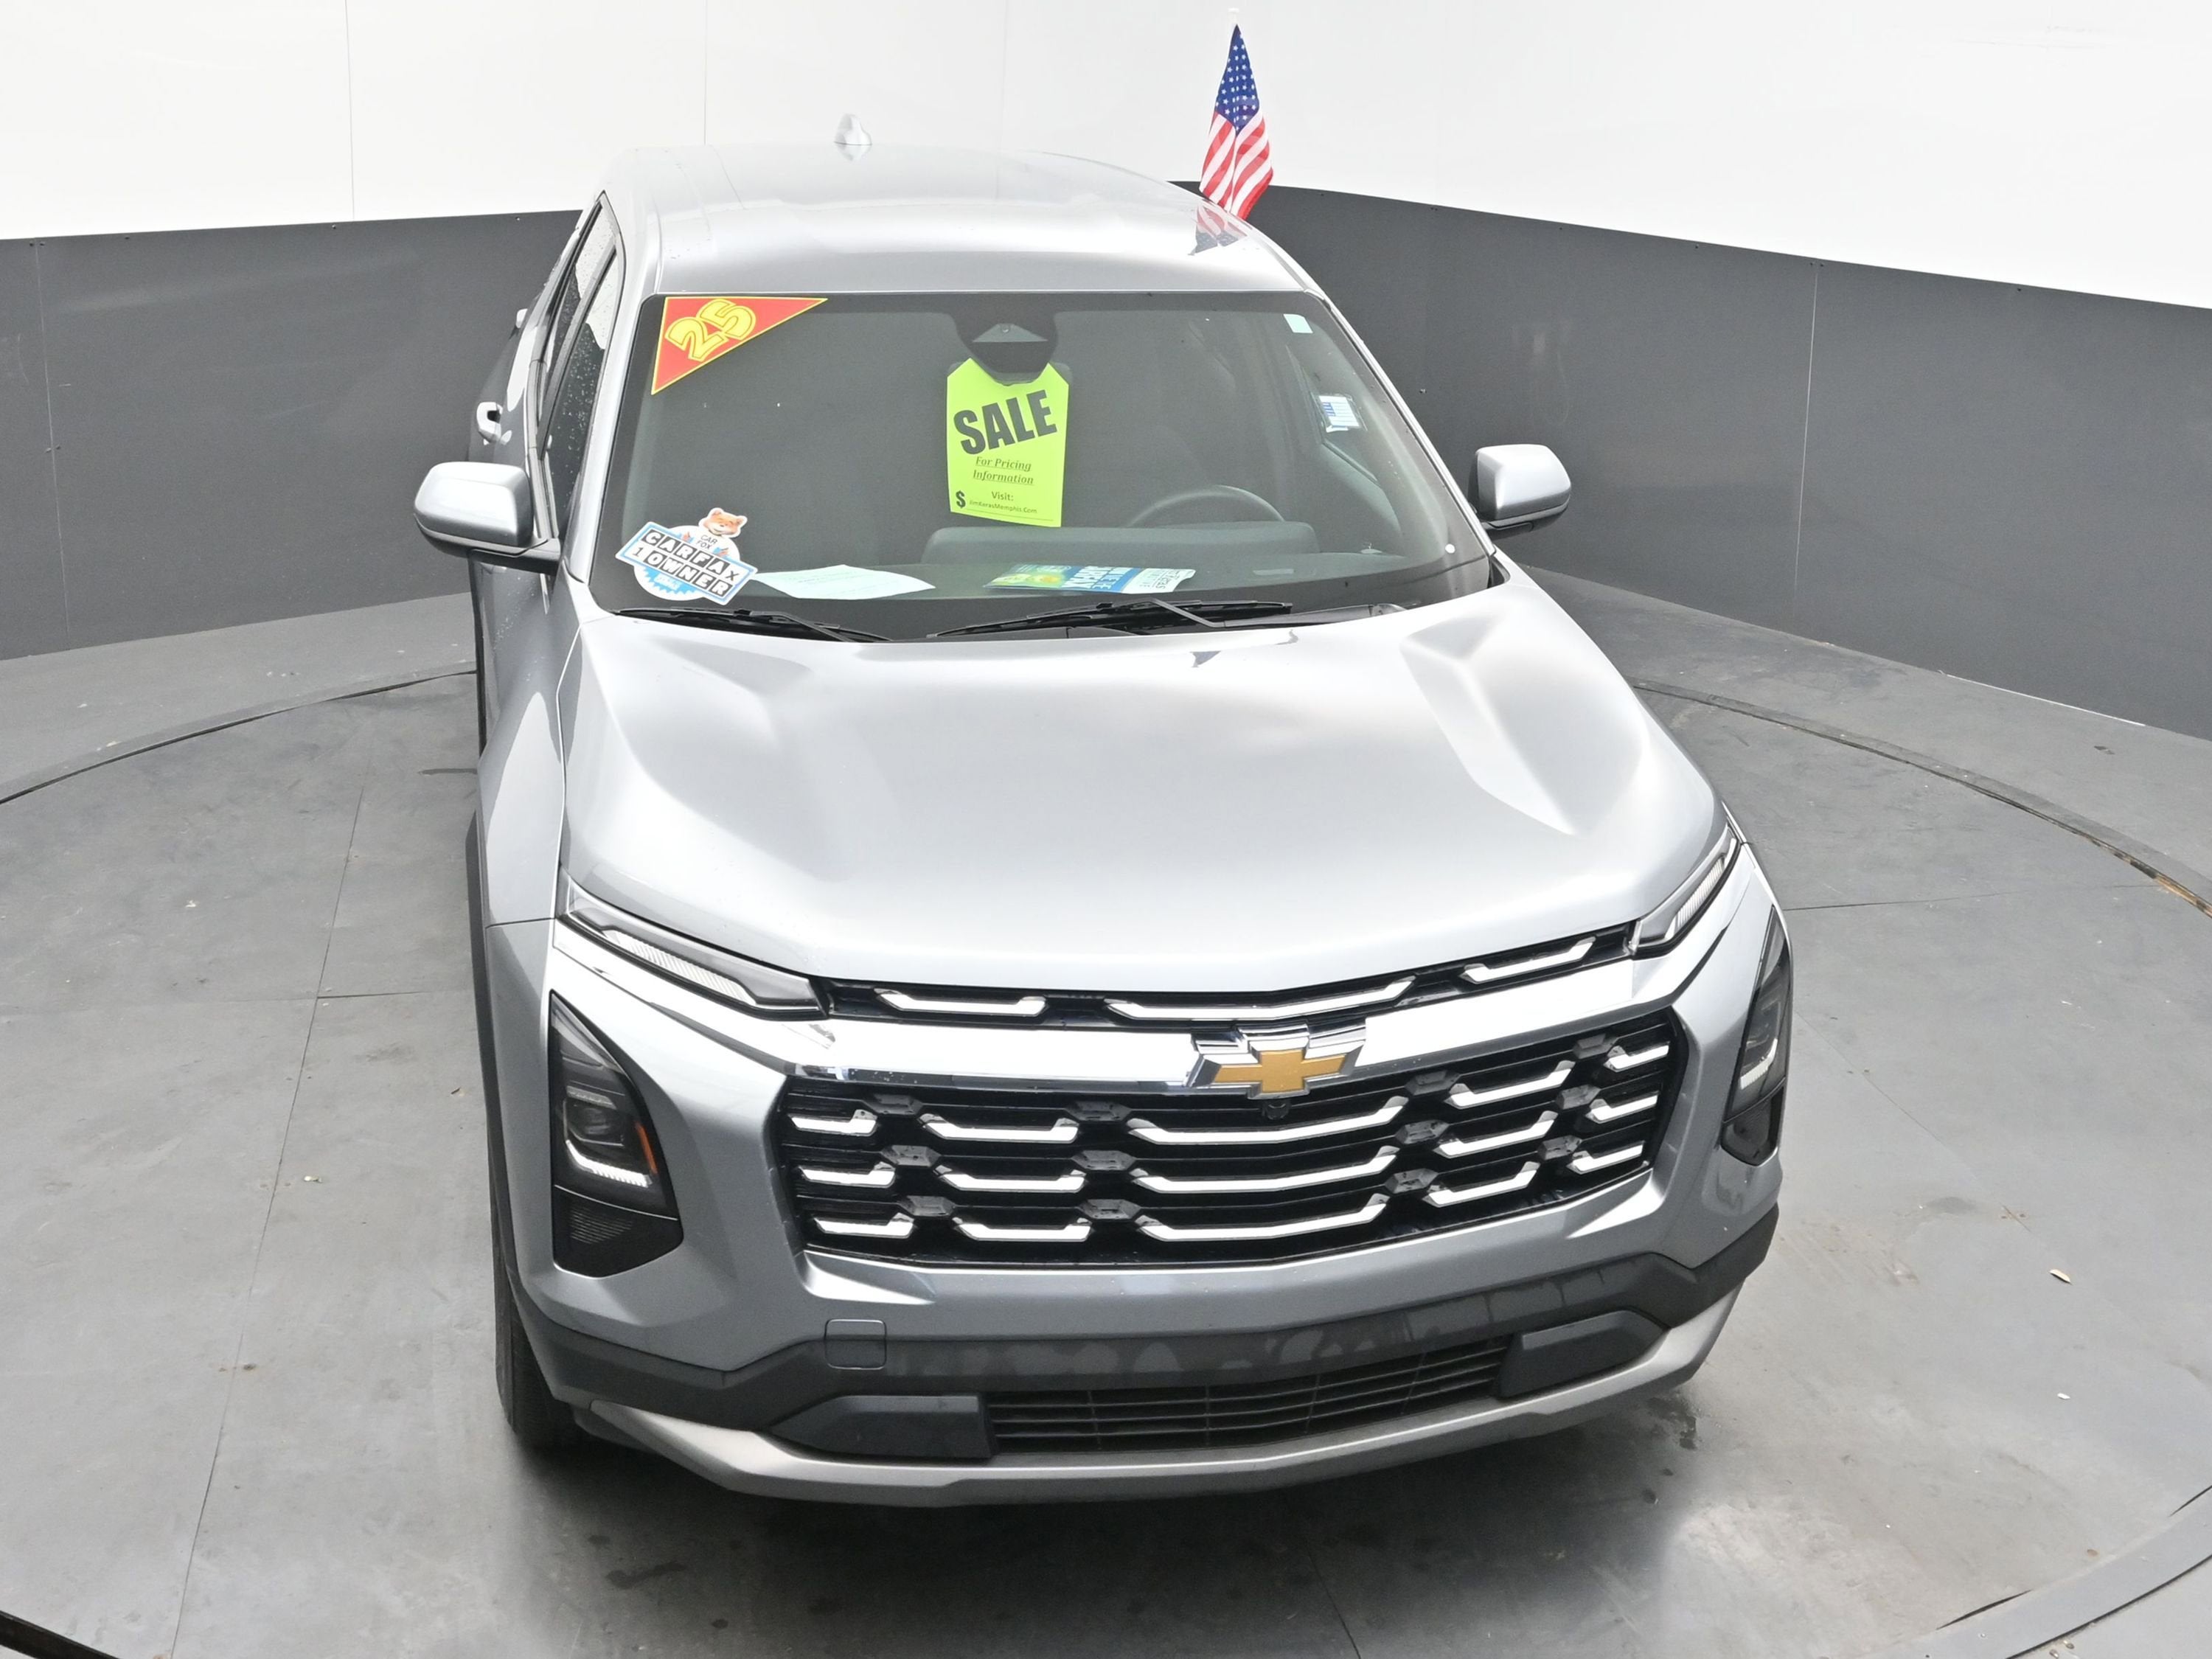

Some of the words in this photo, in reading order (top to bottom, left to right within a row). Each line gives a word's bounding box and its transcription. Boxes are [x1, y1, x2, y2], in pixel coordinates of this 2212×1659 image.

[665, 299, 757, 362] 25
[953, 389, 1057, 454] SALE
[975, 456, 993, 467] For
[995, 459, 1032, 472] Pricing
[973, 470, 1034, 484] Information
[956, 490, 966, 509] $
[991, 490, 1014, 501] Visit:
[695, 540, 712, 550] FOX
[700, 534, 718, 545] CAR
[641, 529, 739, 581] CARFAX
[632, 546, 644, 557] 1
[644, 551, 732, 597] OWNER
